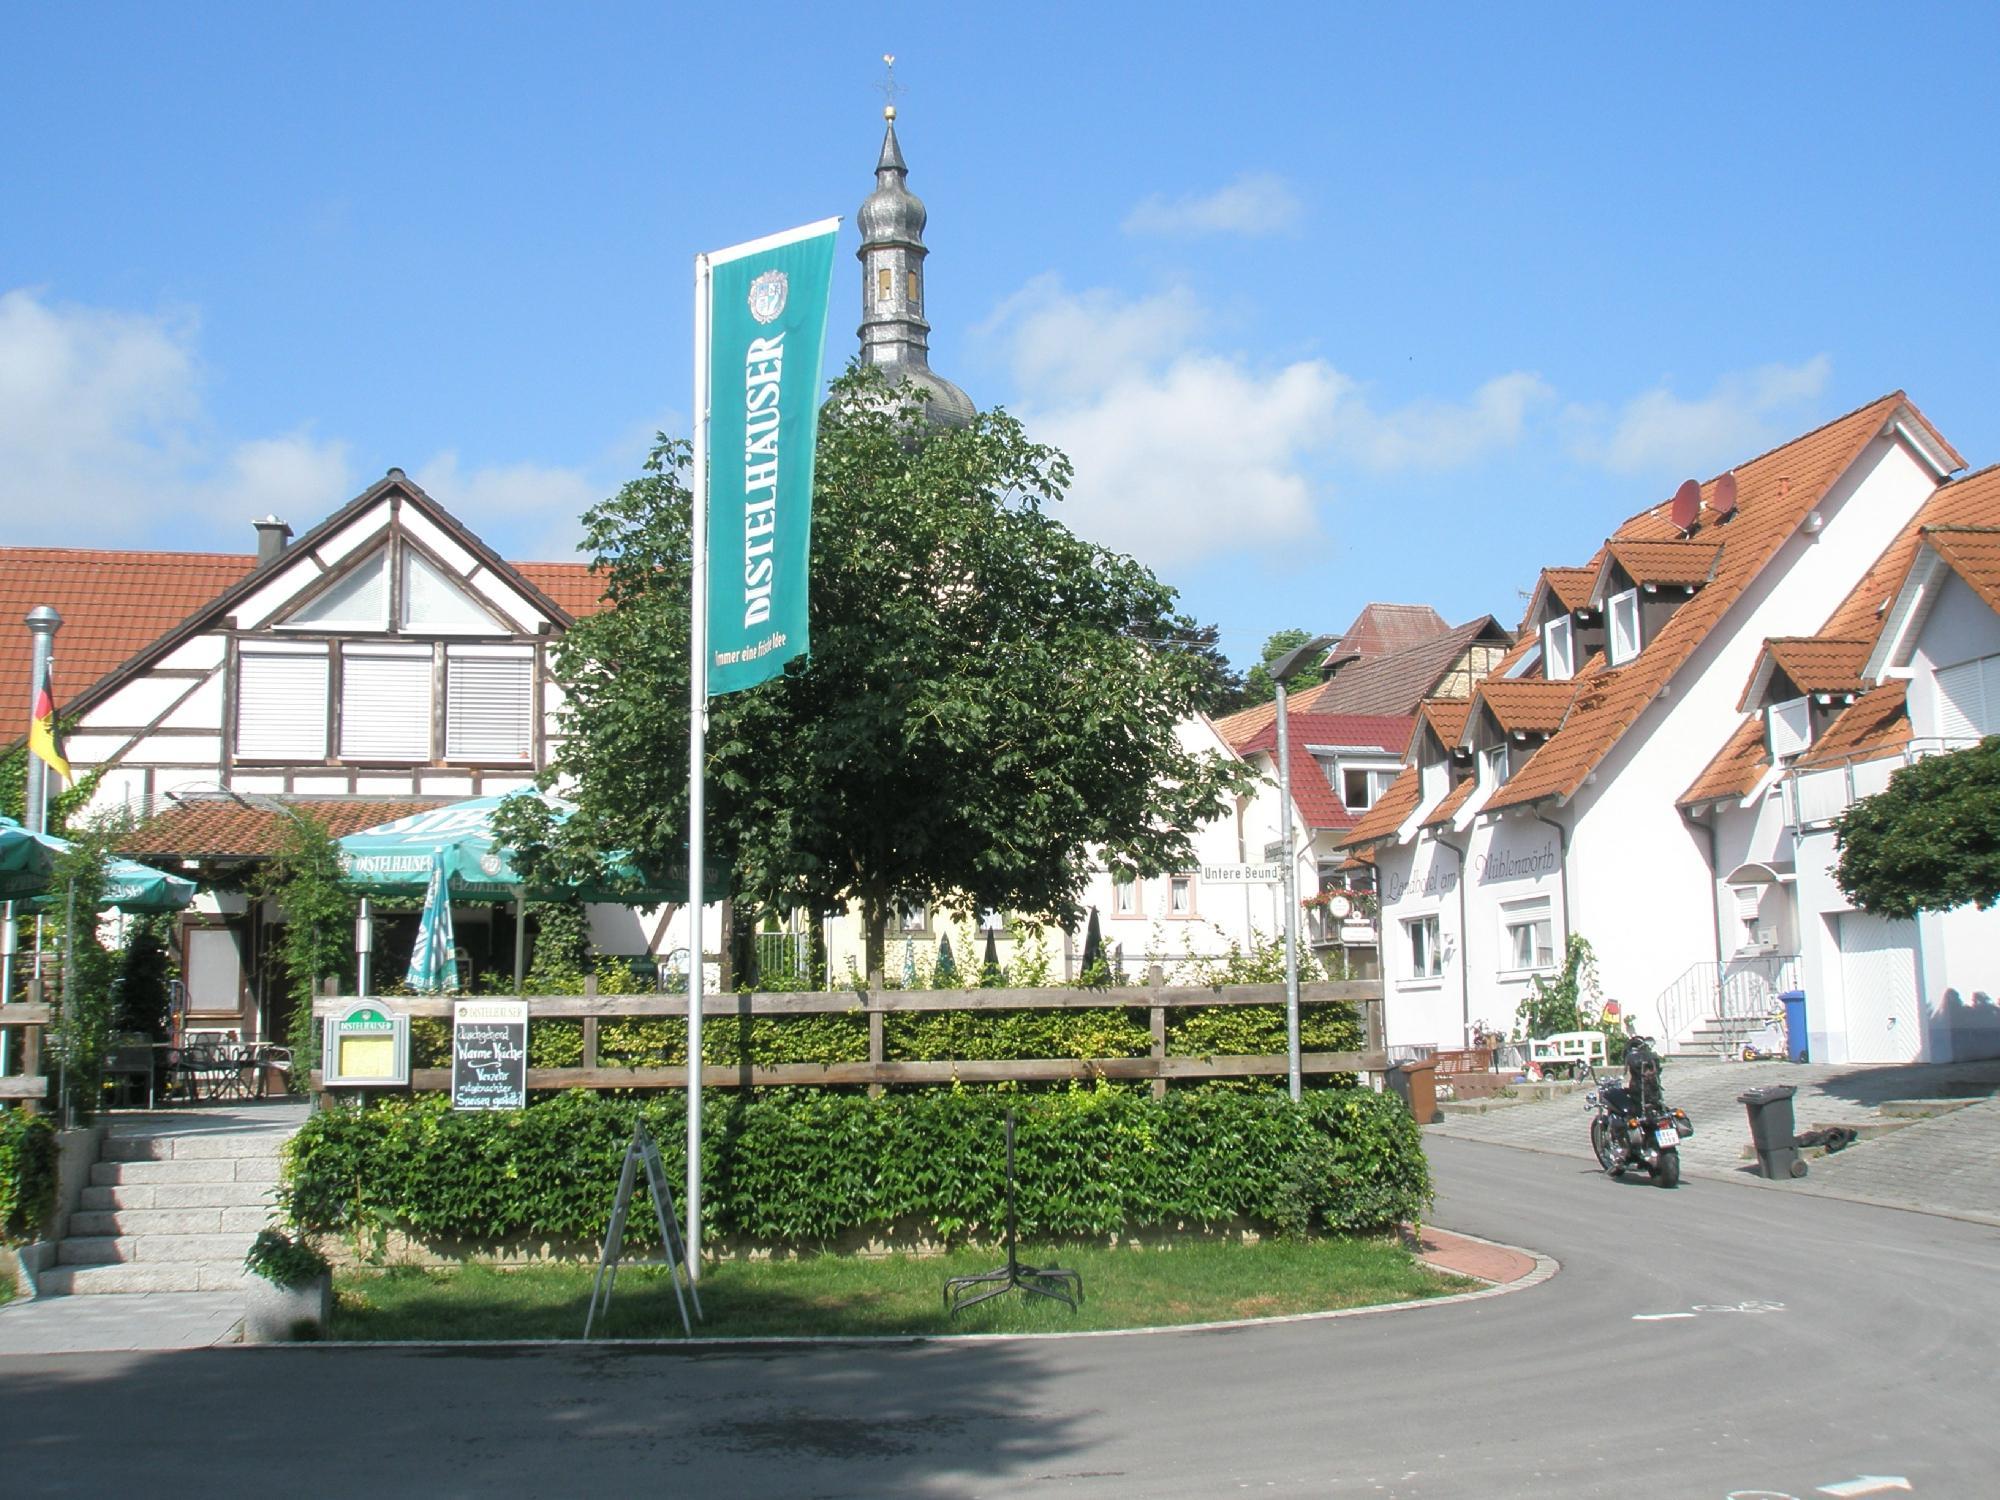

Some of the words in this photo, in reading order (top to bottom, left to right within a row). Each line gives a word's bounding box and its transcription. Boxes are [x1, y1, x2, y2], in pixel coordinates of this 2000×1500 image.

[744, 332, 786, 629] DISTELHÄUSER
[741, 645, 757, 662] eine
[772, 631, 787, 649] Idee
[1205, 867, 1241, 880] Untere
[1245, 866, 1278, 879] Beund
[1440, 872, 1456, 889] am
[456, 1042, 492, 1060] Warme
[492, 1042, 524, 1061] Küche
